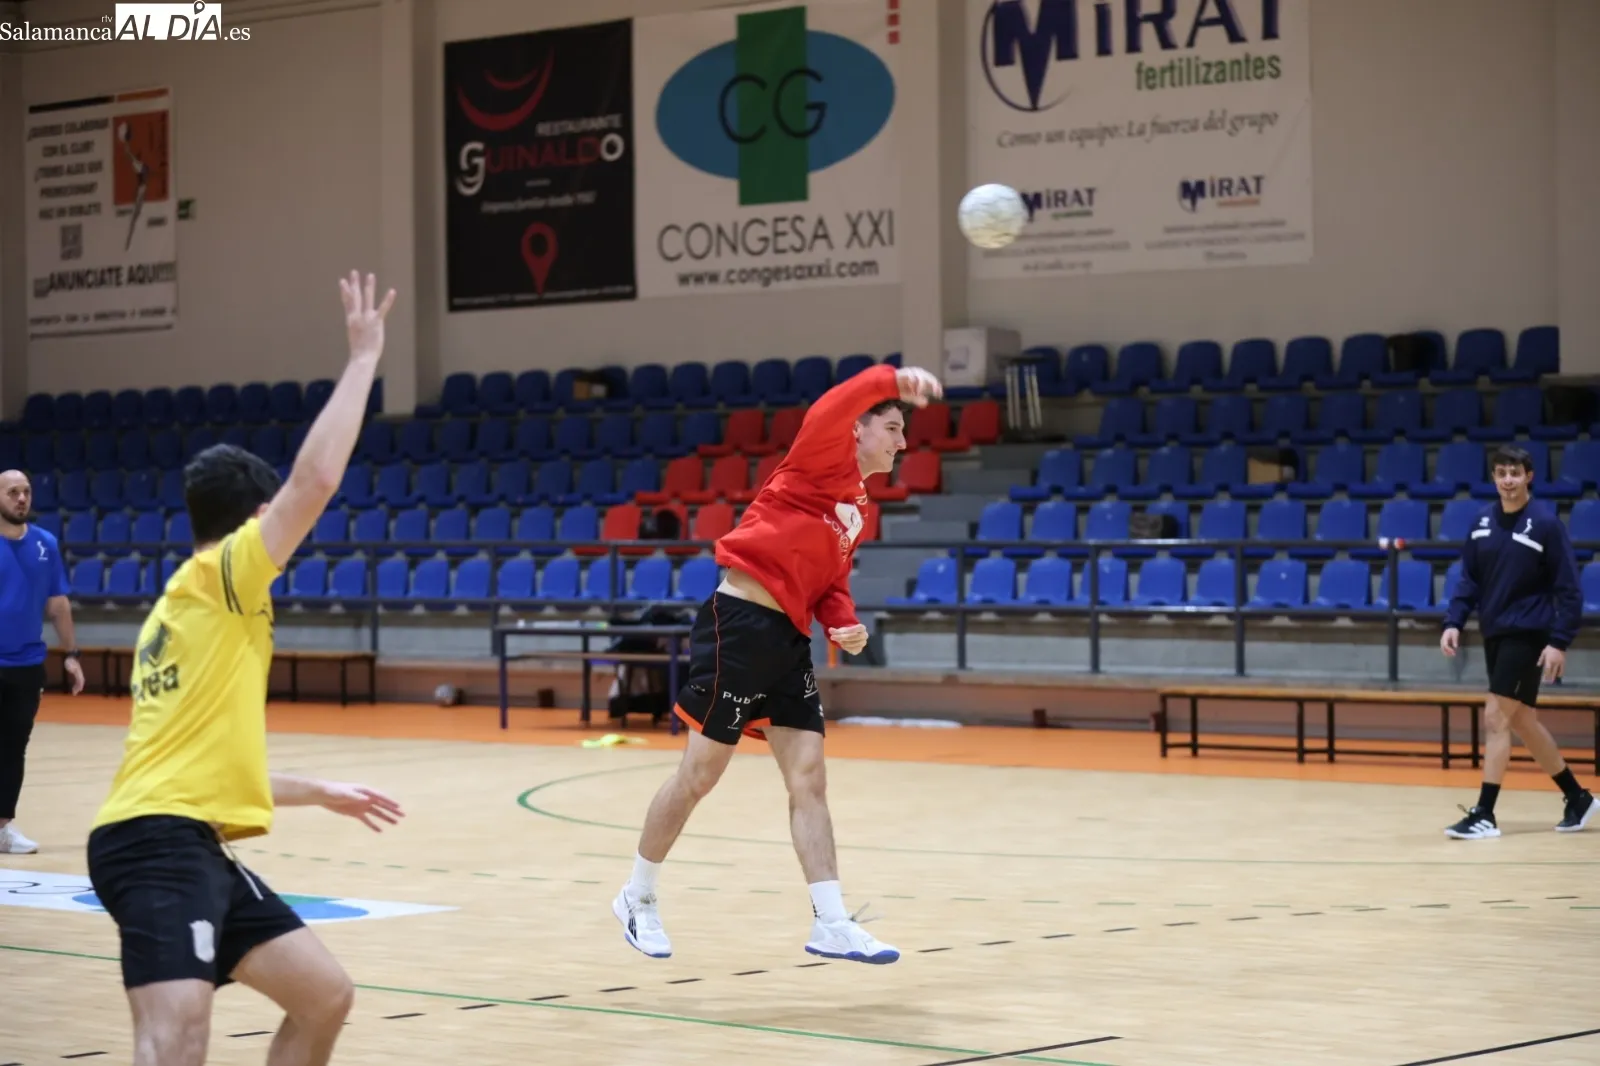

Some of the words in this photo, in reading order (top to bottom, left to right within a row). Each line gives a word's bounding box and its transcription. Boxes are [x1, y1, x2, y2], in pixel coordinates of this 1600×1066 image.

[1135, 53, 1282, 91] fertilizantes
[717, 68, 828, 144] CG
[996, 127, 1043, 149] Como
[1045, 128, 1066, 143] un
[1127, 119, 1147, 137] La
[1147, 113, 1200, 143] fuerza
[1202, 108, 1227, 133] del
[1227, 110, 1280, 138] grupo
[455, 132, 625, 196] GUINALDO
[656, 213, 835, 262] CONGESA
[844, 207, 895, 250] XXI
[676, 257, 880, 288] www.congesaxxi.com
